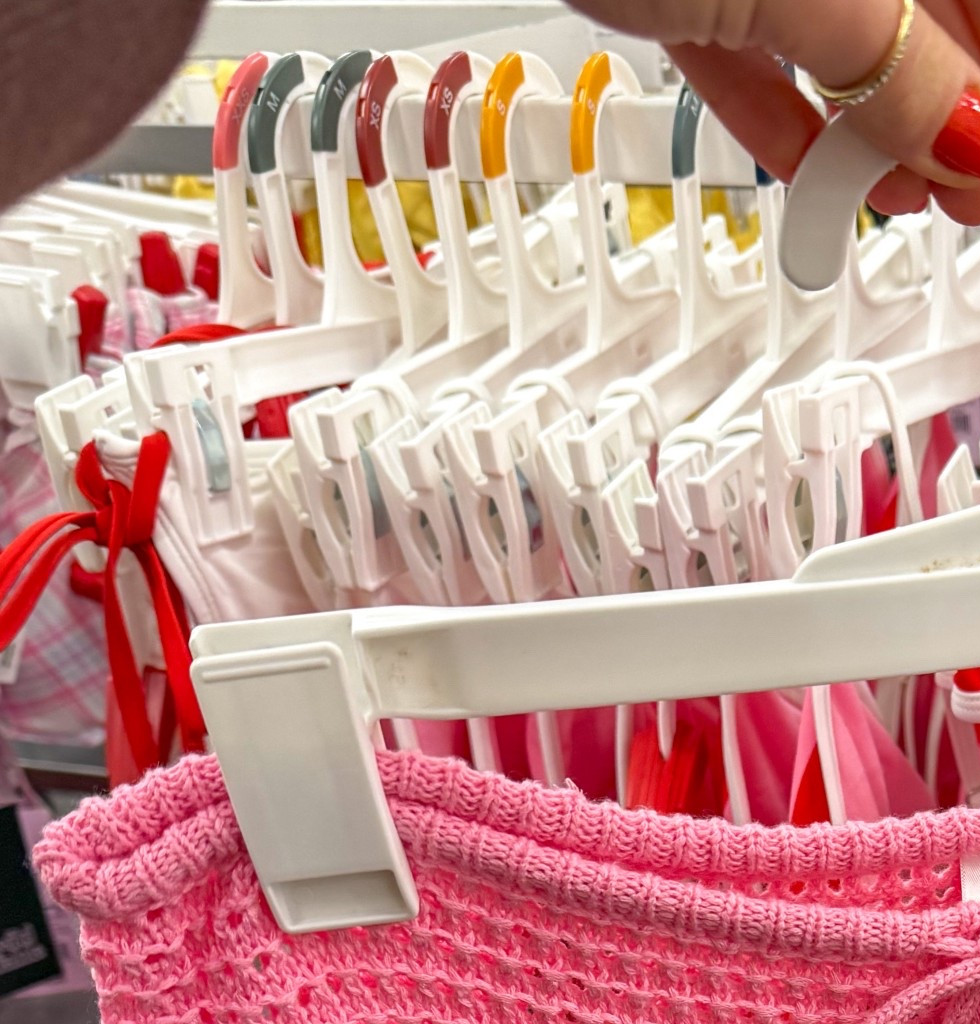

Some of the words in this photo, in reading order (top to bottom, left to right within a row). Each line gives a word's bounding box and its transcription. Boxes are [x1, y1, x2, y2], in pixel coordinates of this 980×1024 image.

[334, 79, 347, 101] M
[267, 91, 280, 113] M
[439, 87, 454, 116] XS
[496, 98, 507, 116] S
[587, 98, 597, 116] S
[369, 101, 382, 130] XS
